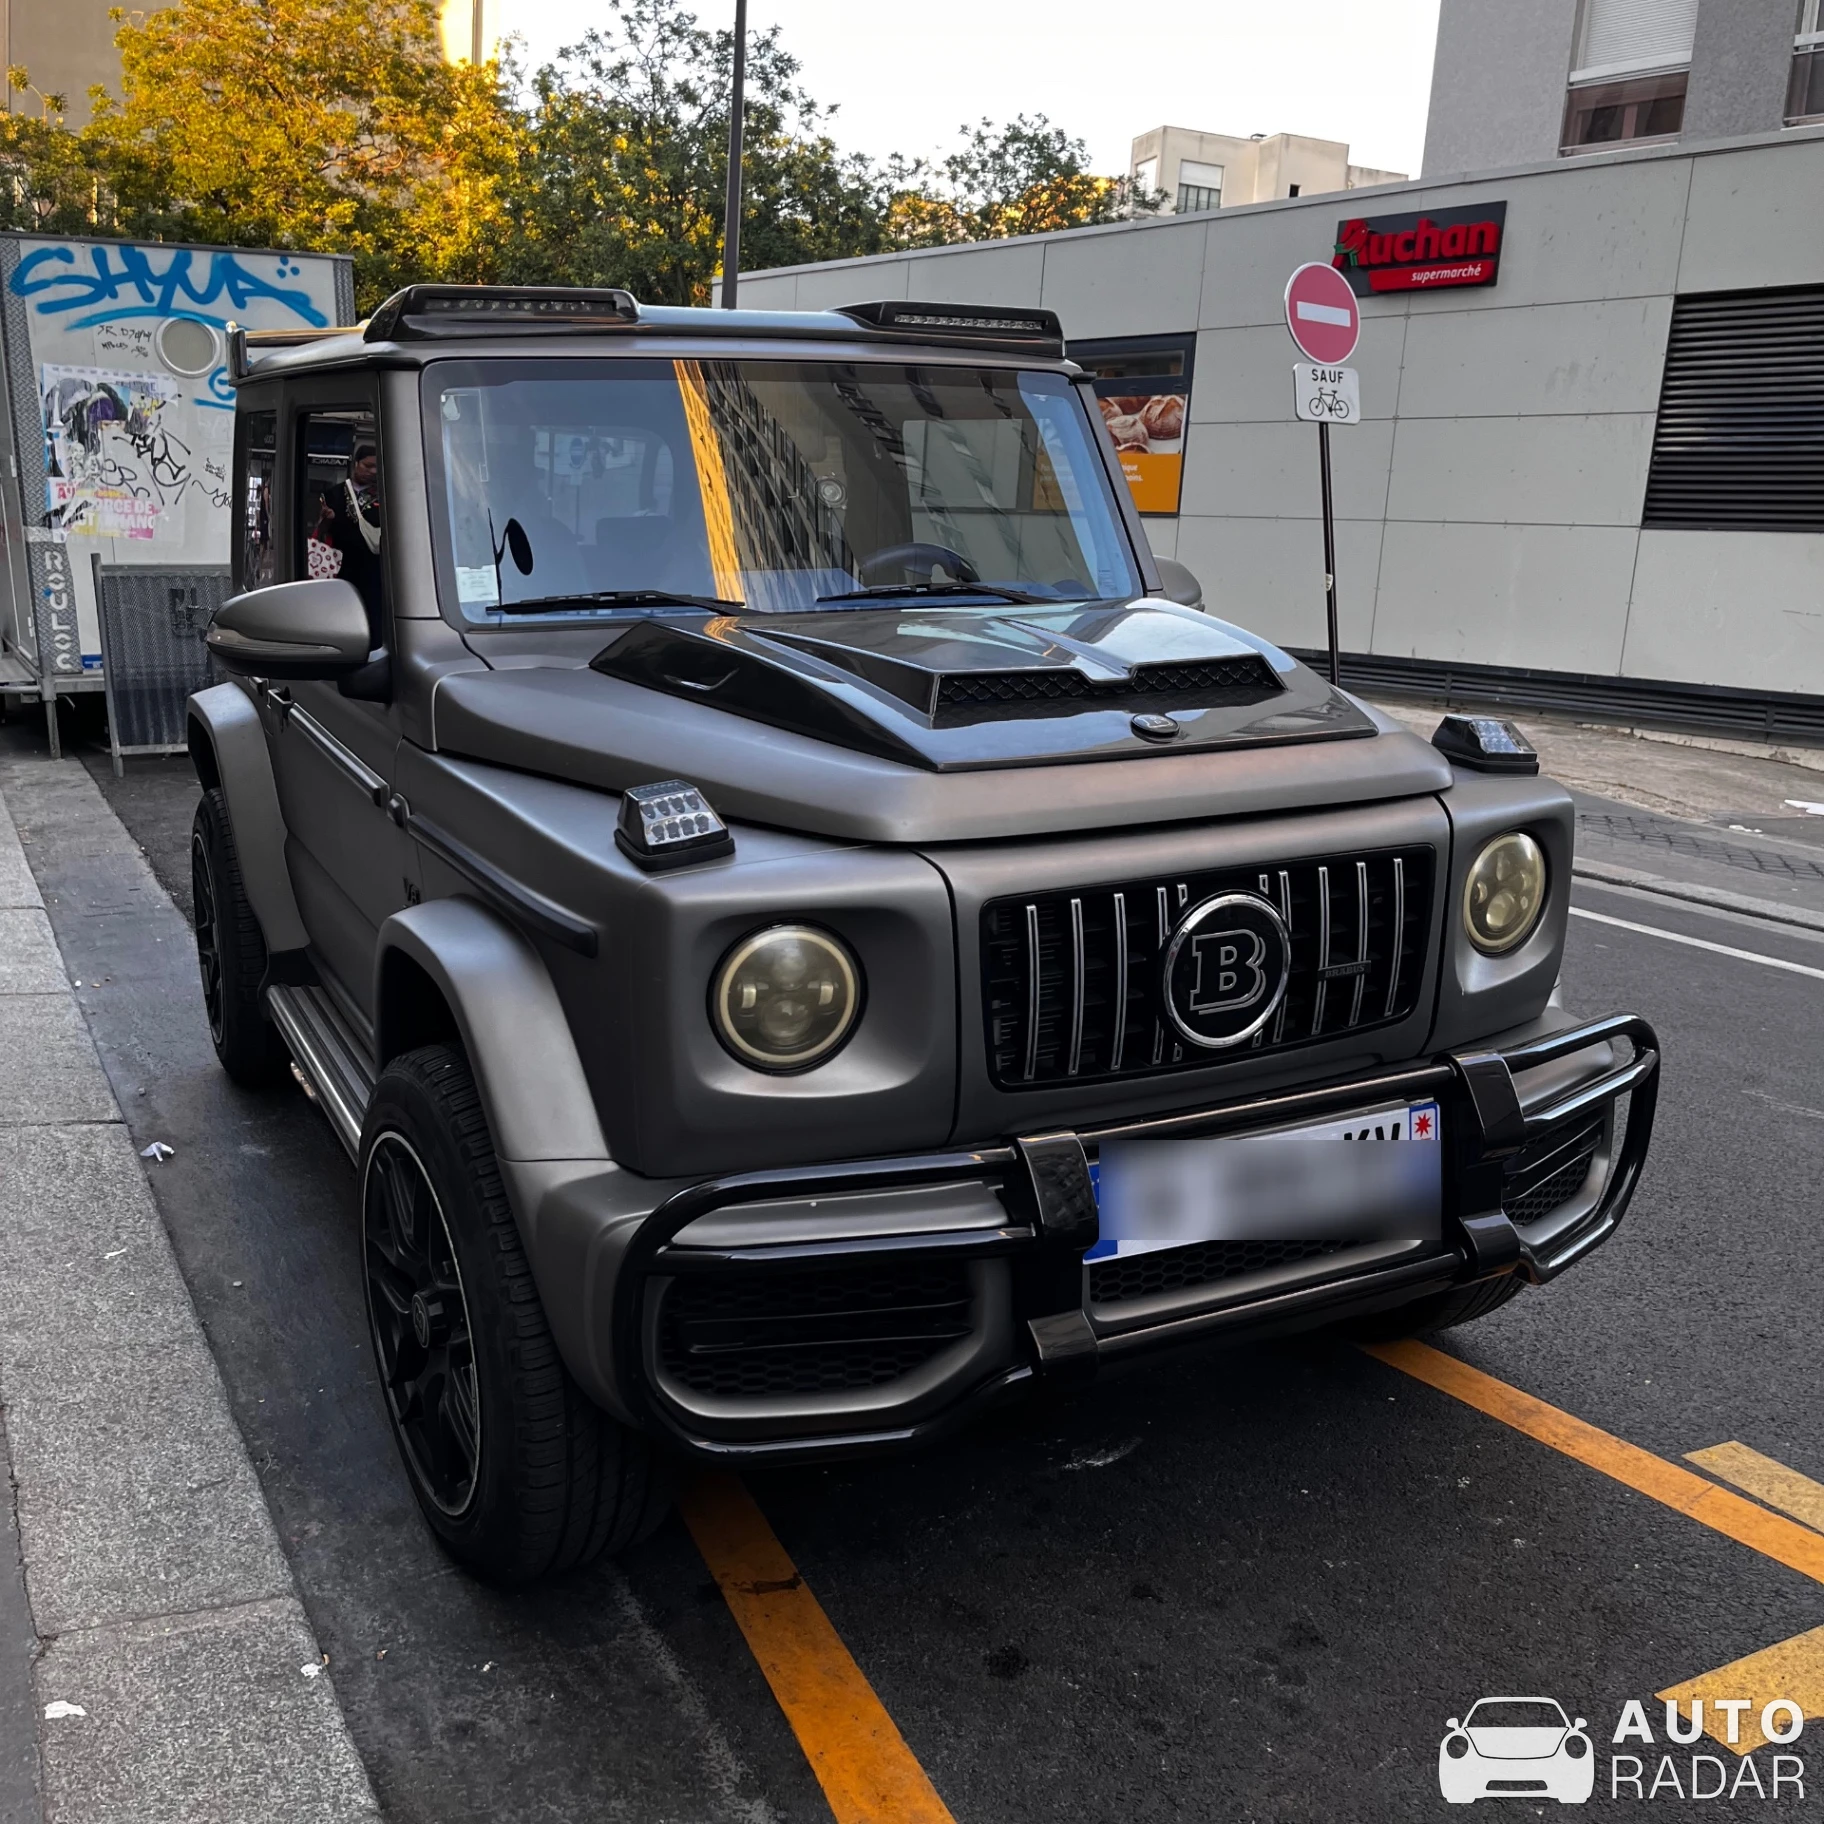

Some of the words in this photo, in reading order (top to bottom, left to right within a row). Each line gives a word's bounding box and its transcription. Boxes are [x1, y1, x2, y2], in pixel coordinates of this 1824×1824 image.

[1332, 218, 1499, 268] Auchan
[1411, 264, 1482, 284] supermarché
[1312, 368, 1344, 384] SAUF
[1190, 929, 1266, 1015] B
[1325, 965, 1365, 978] BRABUS
